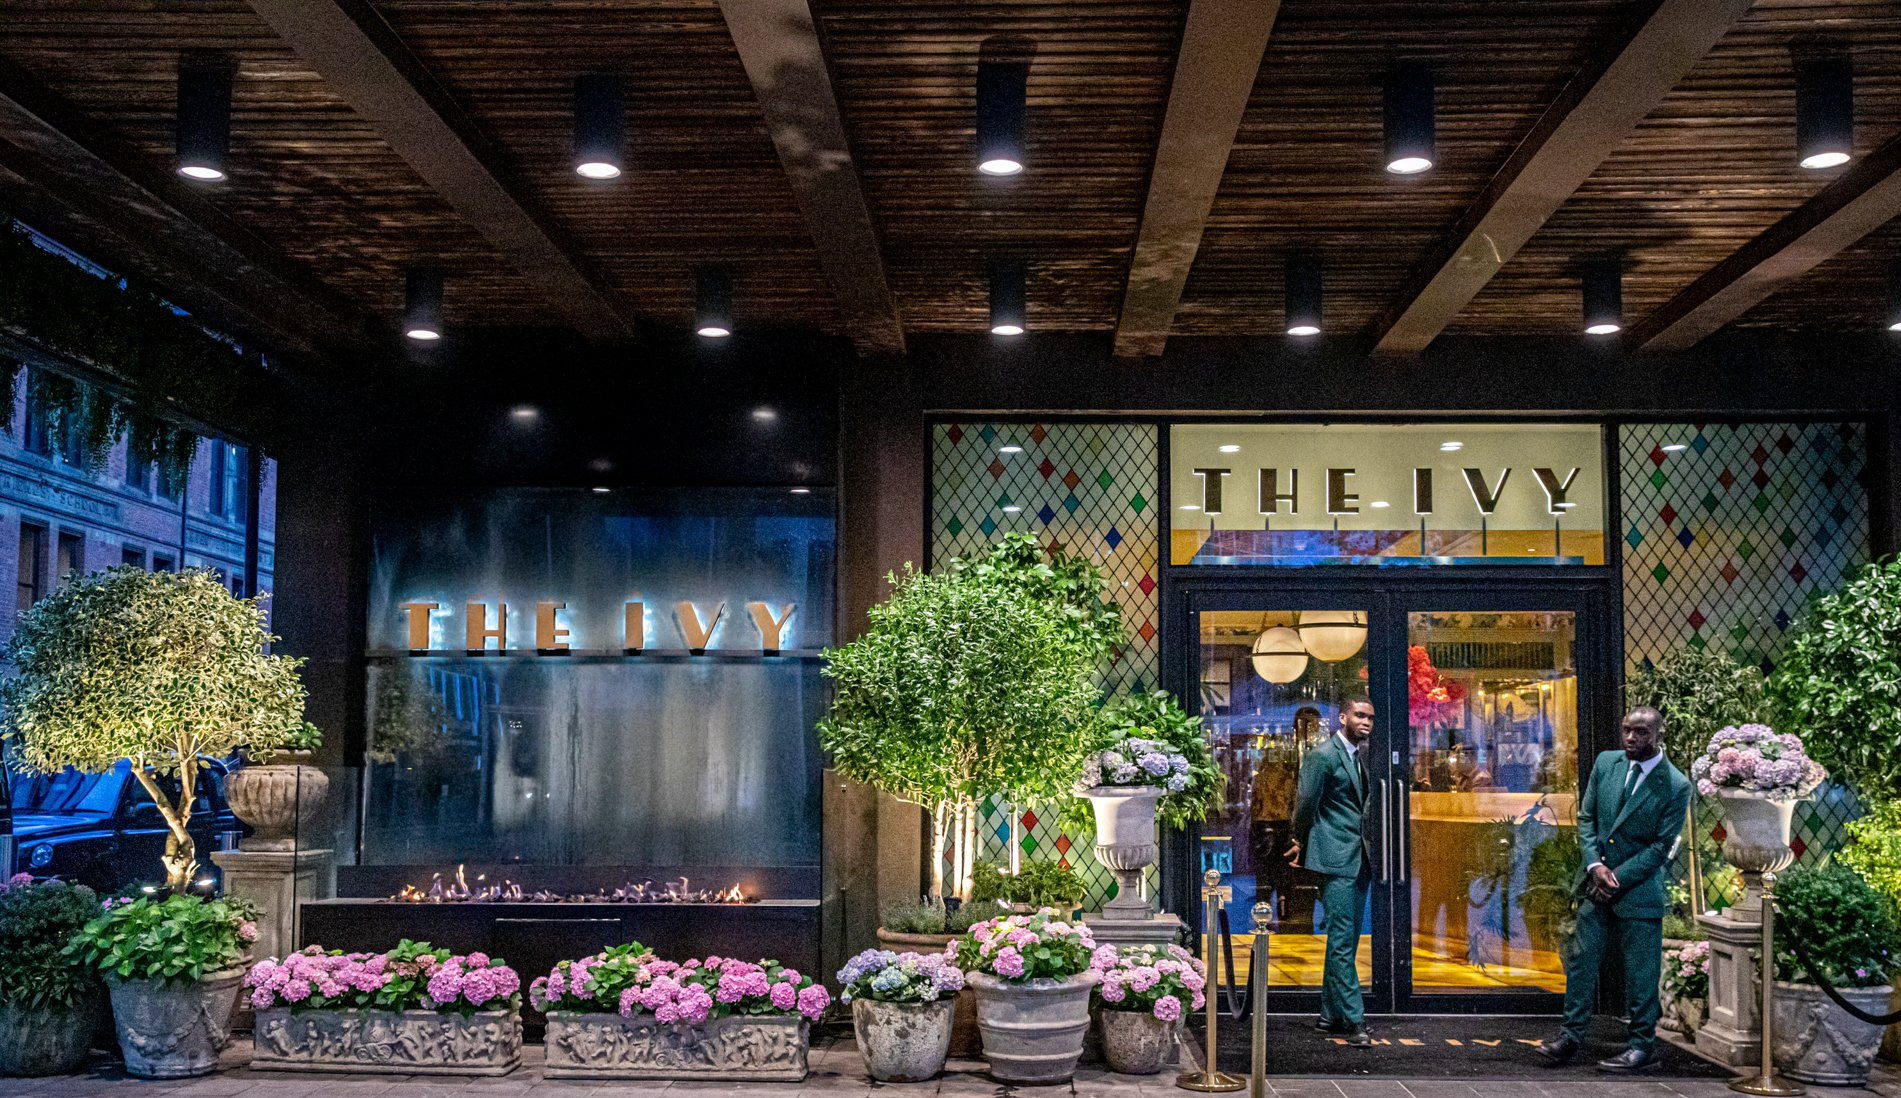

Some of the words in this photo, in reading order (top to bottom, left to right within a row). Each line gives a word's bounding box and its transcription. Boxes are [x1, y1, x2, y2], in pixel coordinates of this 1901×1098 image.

[60, 493, 102, 515] SCHOOL
[1193, 467, 1360, 515] THE
[1413, 467, 1581, 515] IVY
[402, 602, 570, 650] THE
[624, 602, 796, 650] IVY
[1445, 1038, 1544, 1047] IVY
